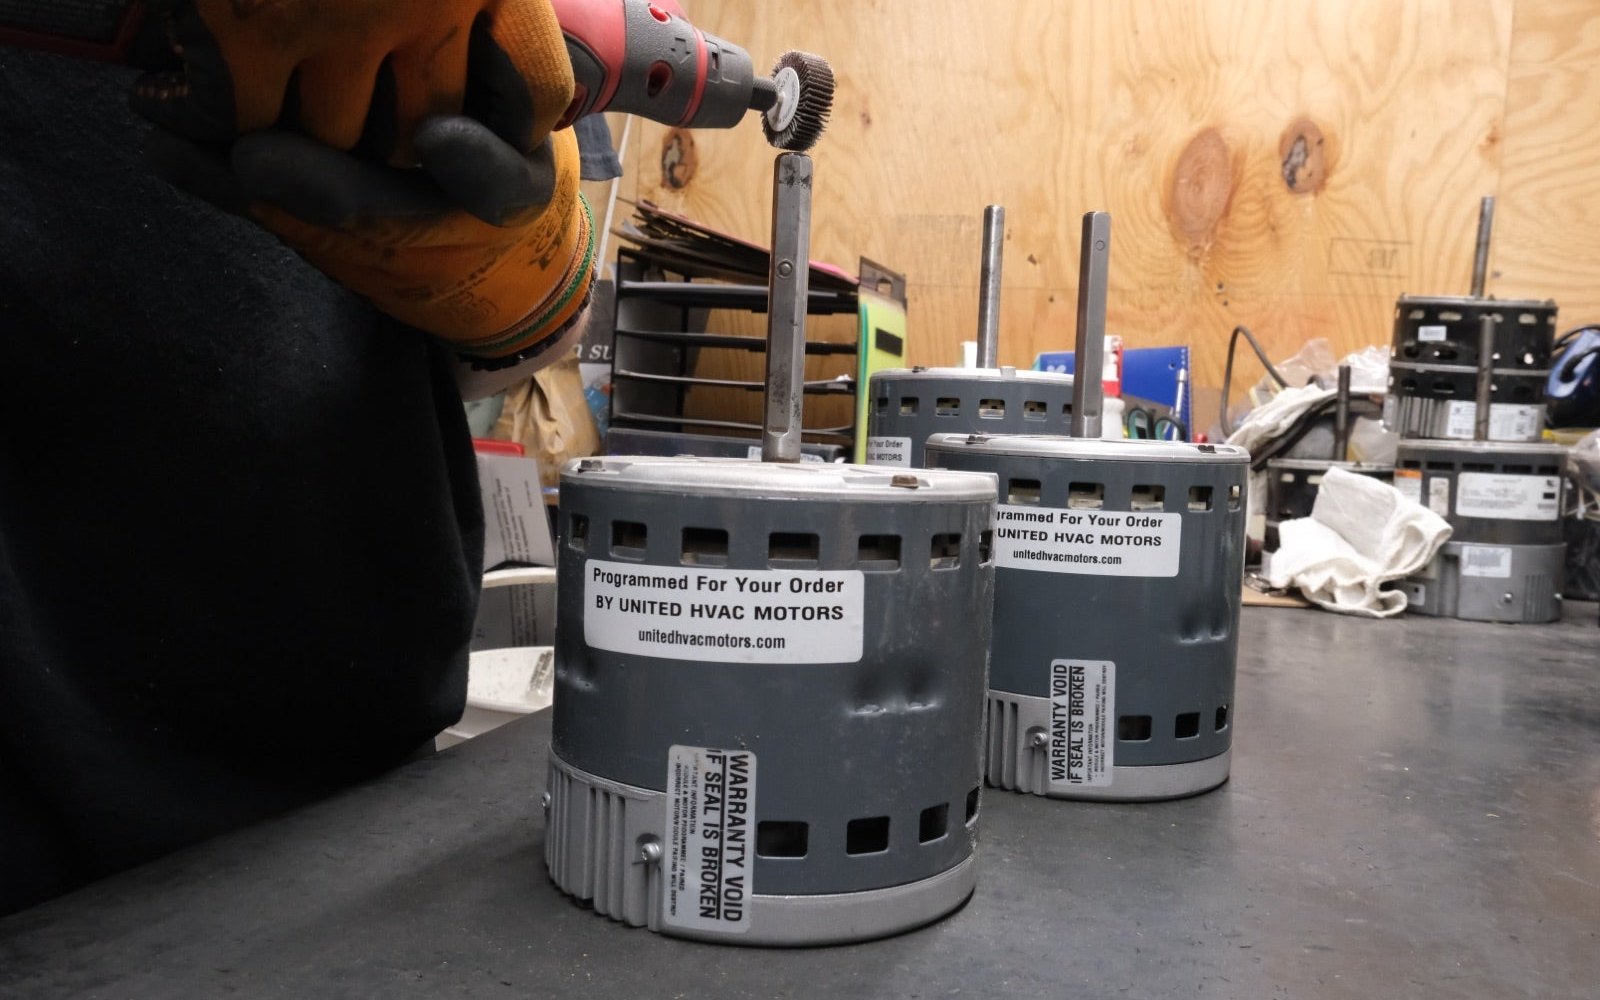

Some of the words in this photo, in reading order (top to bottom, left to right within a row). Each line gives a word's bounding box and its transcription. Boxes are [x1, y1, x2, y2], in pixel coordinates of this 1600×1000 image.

[1060, 513, 1083, 524] For
[1088, 515, 1120, 527] Your
[1126, 515, 1162, 527] Order
[998, 528, 1048, 541] UNITED
[1055, 533, 1094, 544] HVAC
[1101, 535, 1162, 546] MOTORS
[1013, 549, 1122, 565] unitedhvacmotors.com
[593, 567, 689, 590] Programmed
[697, 576, 727, 592] For
[735, 577, 782, 593] Your
[789, 577, 845, 593] Order
[596, 595, 613, 610] BY
[619, 598, 682, 617] UNITED
[690, 604, 744, 620] HVAC
[754, 605, 844, 621] MOTORS
[638, 629, 786, 649] unitedhvacmotors.com
[1053, 664, 1067, 697] VOID
[1072, 666, 1084, 716] BROKEN
[1071, 721, 1084, 733] IS
[1052, 702, 1066, 780] WARRANTY
[1071, 737, 1083, 768] SEAL
[706, 748, 722, 764] IF
[1071, 773, 1082, 784] IF
[703, 772, 721, 815] SEAL
[726, 755, 749, 868] WARRANTY
[703, 823, 719, 839] IS
[700, 846, 718, 919] BROKEN
[724, 876, 744, 922] VOID
